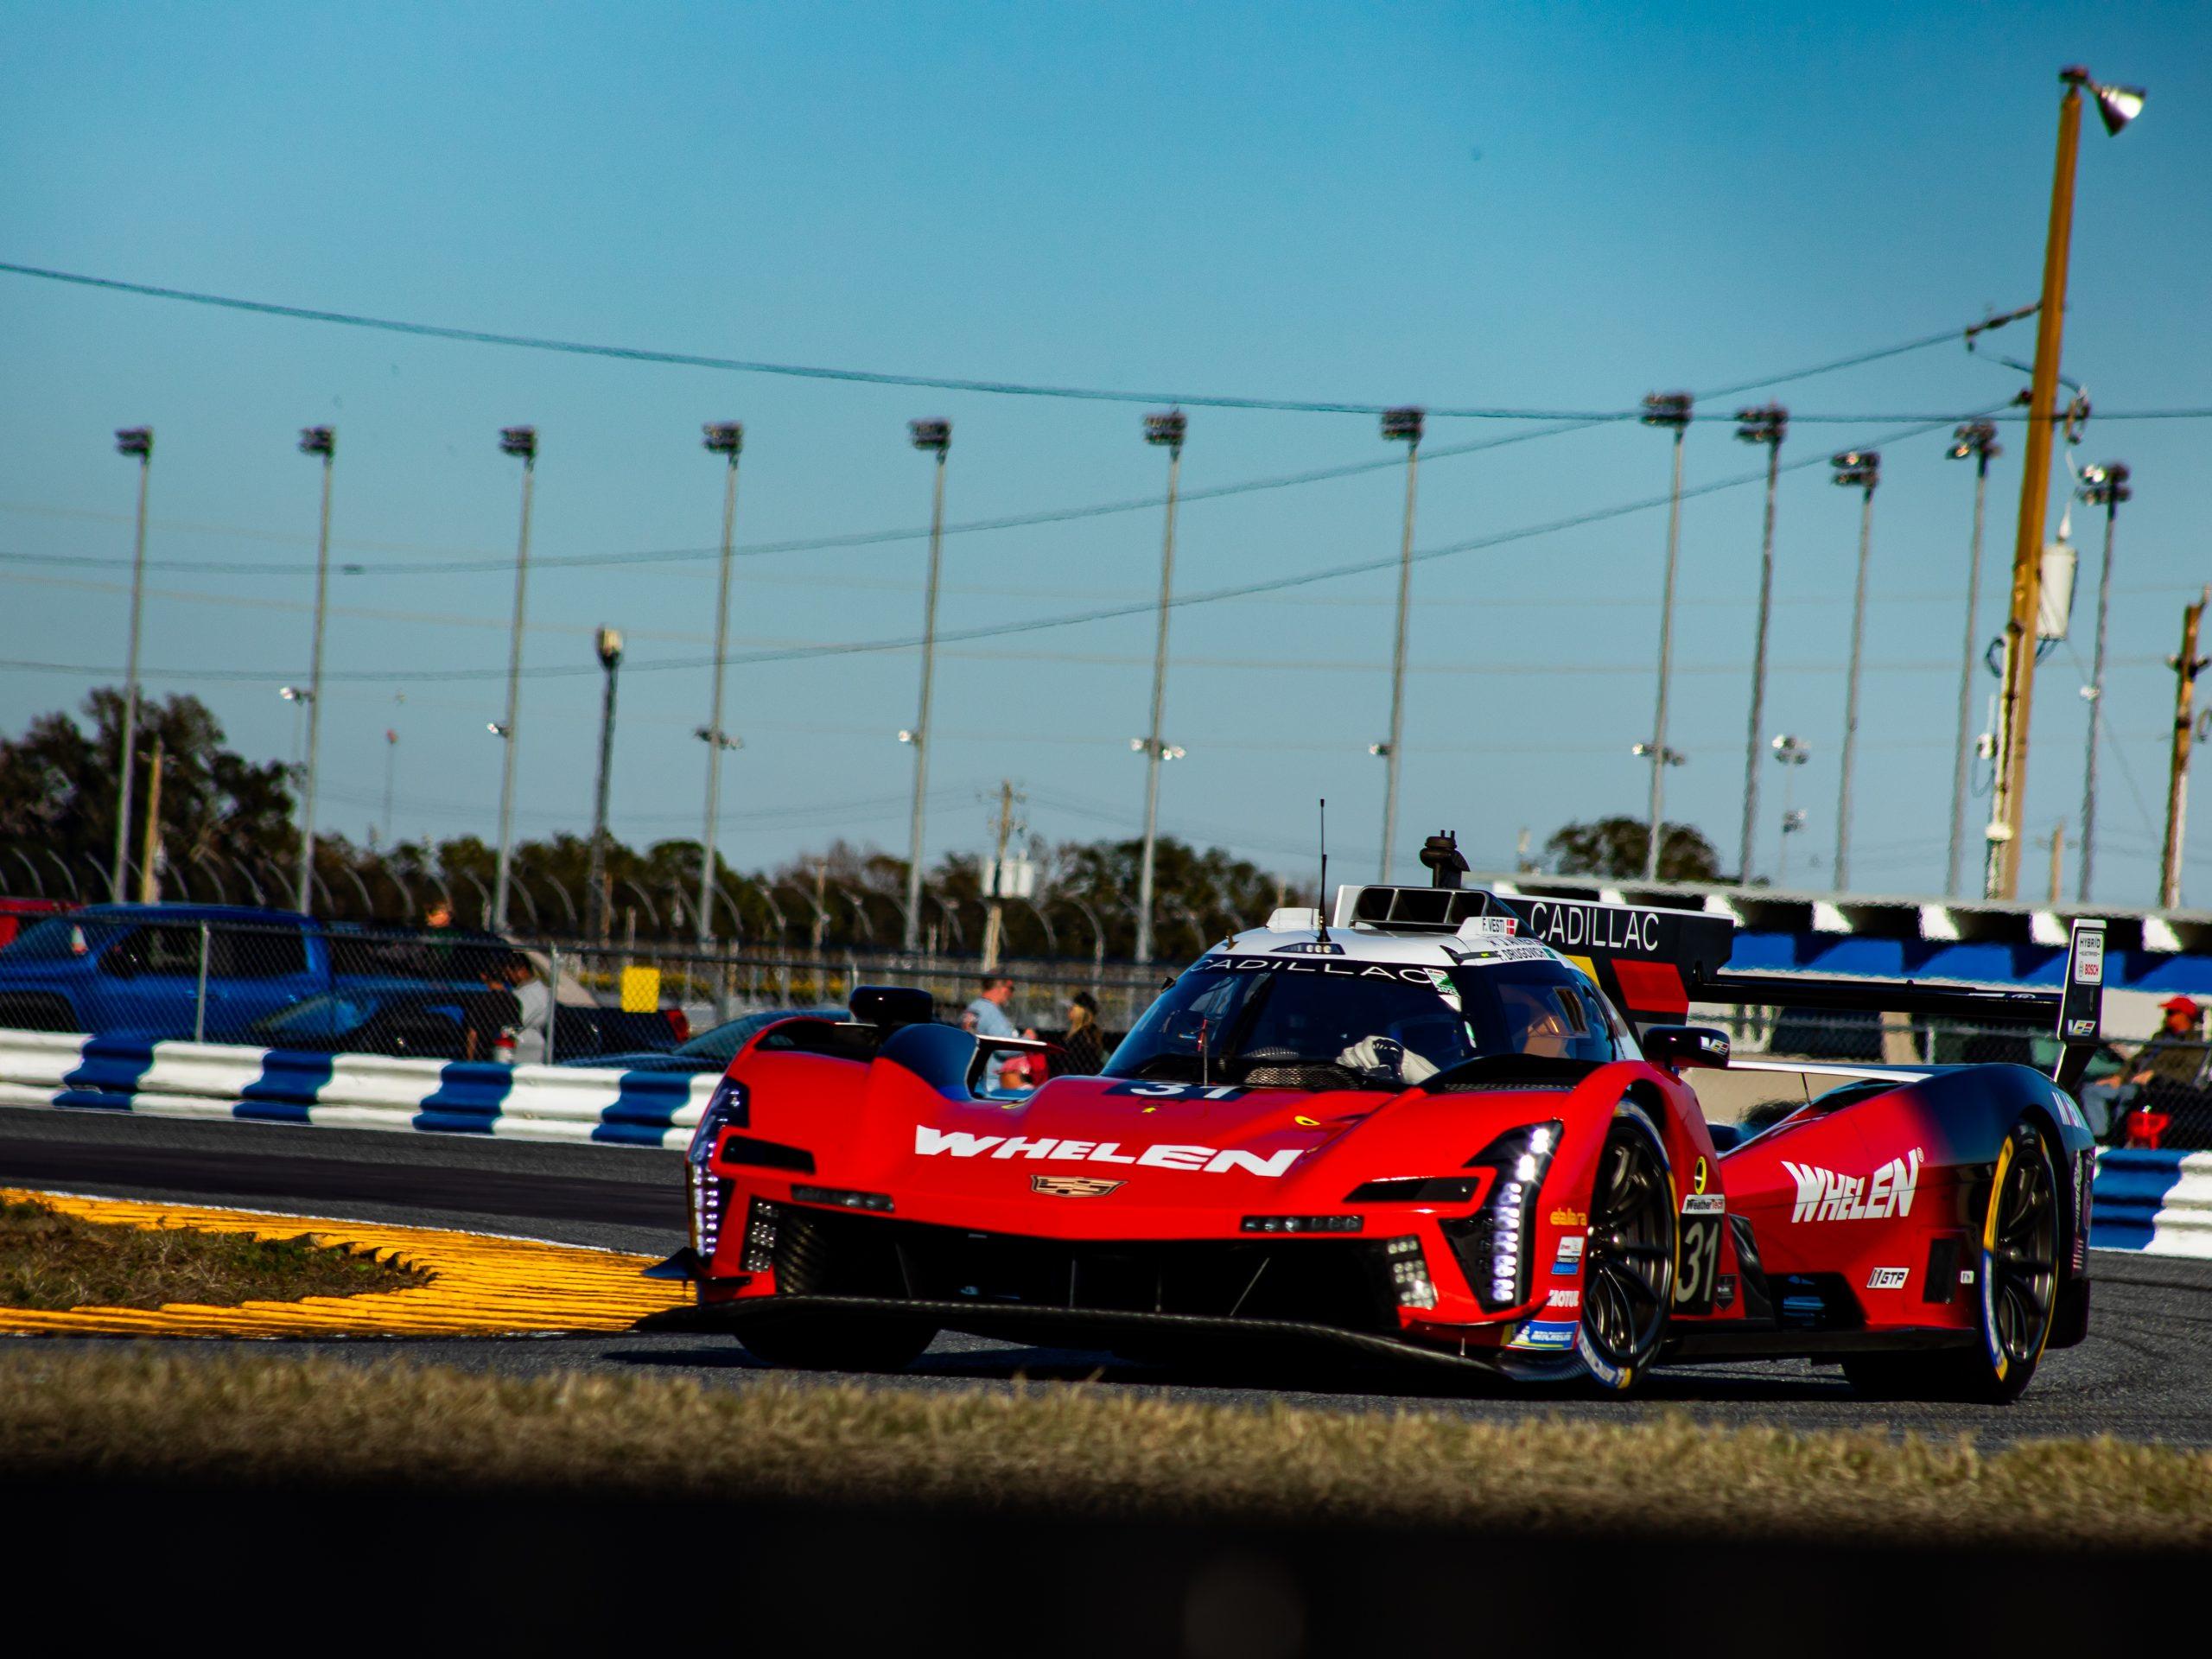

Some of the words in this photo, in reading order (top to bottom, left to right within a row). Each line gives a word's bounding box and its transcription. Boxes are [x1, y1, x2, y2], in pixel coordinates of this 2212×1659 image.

[1531, 902, 1659, 950] CADILLAC
[2080, 938, 2101, 948] HYBRID
[1190, 958, 1433, 984] CADILLAC
[2084, 964, 2099, 976] BOSCH
[1130, 1082, 1242, 1099] 31
[915, 1125, 1304, 1177] WHELEN
[1675, 1222, 1719, 1302] 31
[1880, 1272, 1905, 1285] GTP
